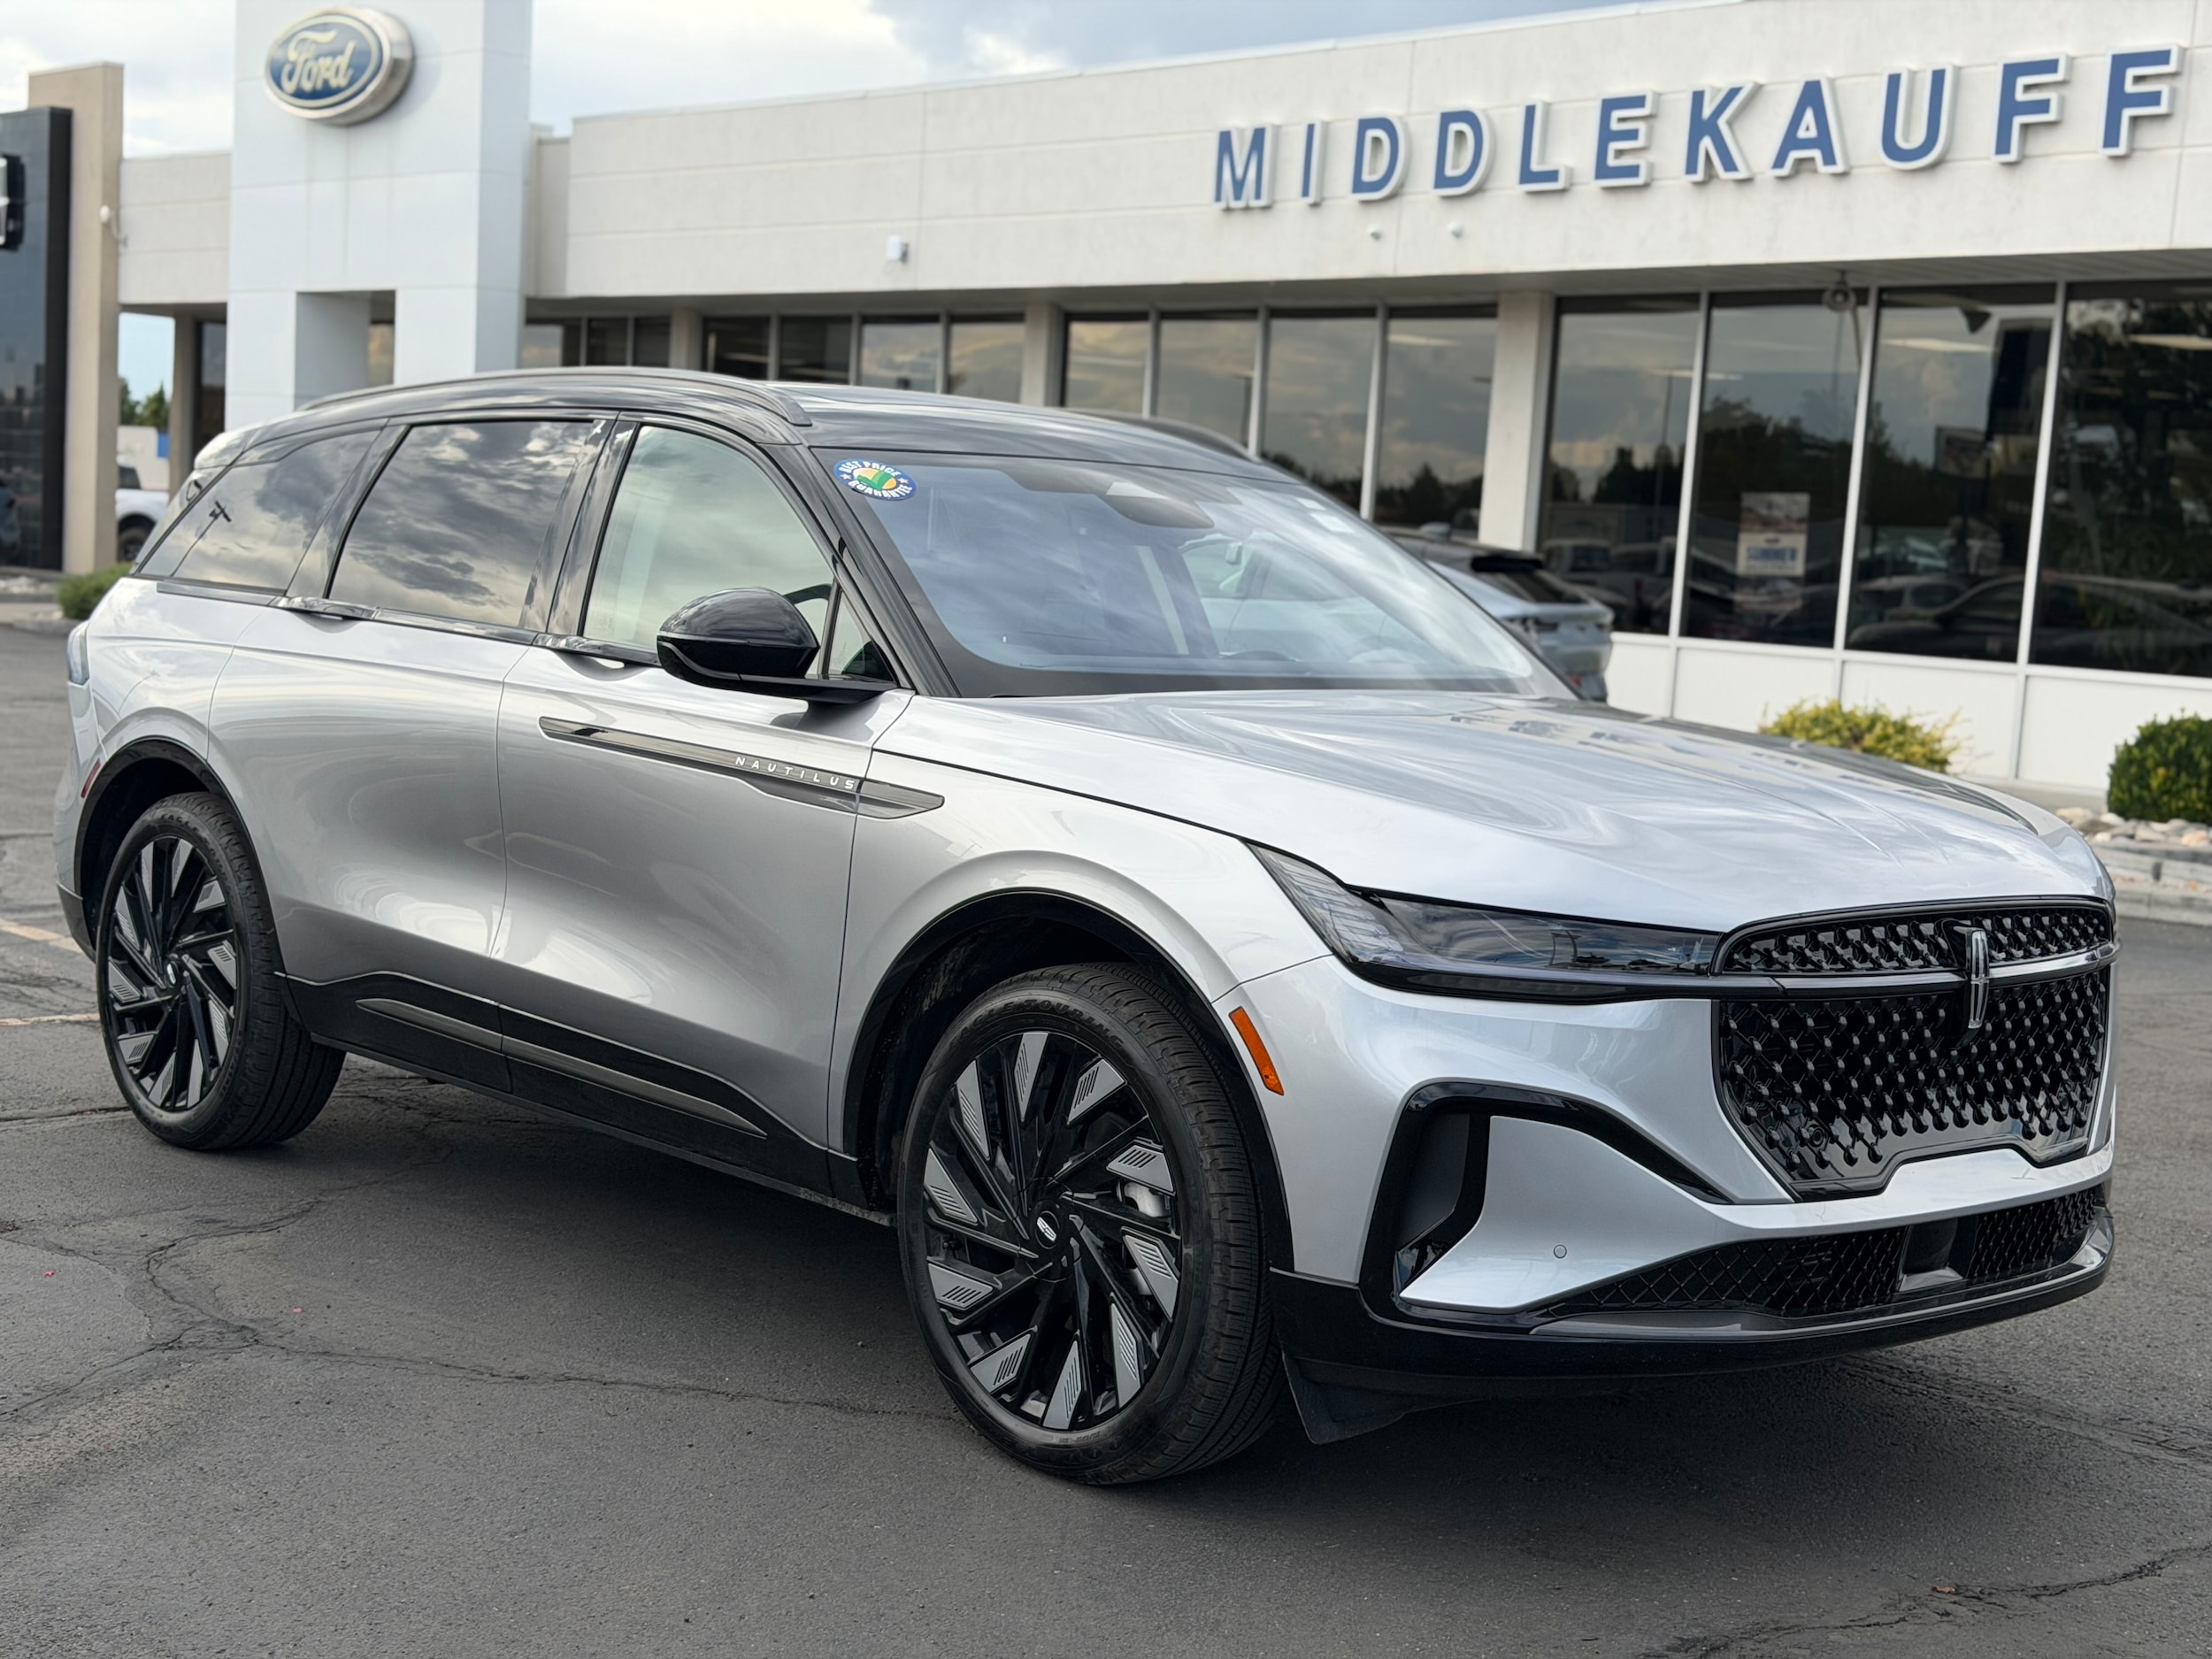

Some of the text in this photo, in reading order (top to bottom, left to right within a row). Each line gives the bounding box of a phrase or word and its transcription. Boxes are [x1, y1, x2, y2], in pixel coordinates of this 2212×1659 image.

[280, 29, 357, 94] Ford
[1214, 46, 2179, 207] MIDDLEKAUFF
[848, 480, 913, 497] GUARANTEE
[863, 461, 902, 477] PRICE
[735, 757, 855, 789] NAUTILUS
[1025, 999, 1124, 1049] TOURING
